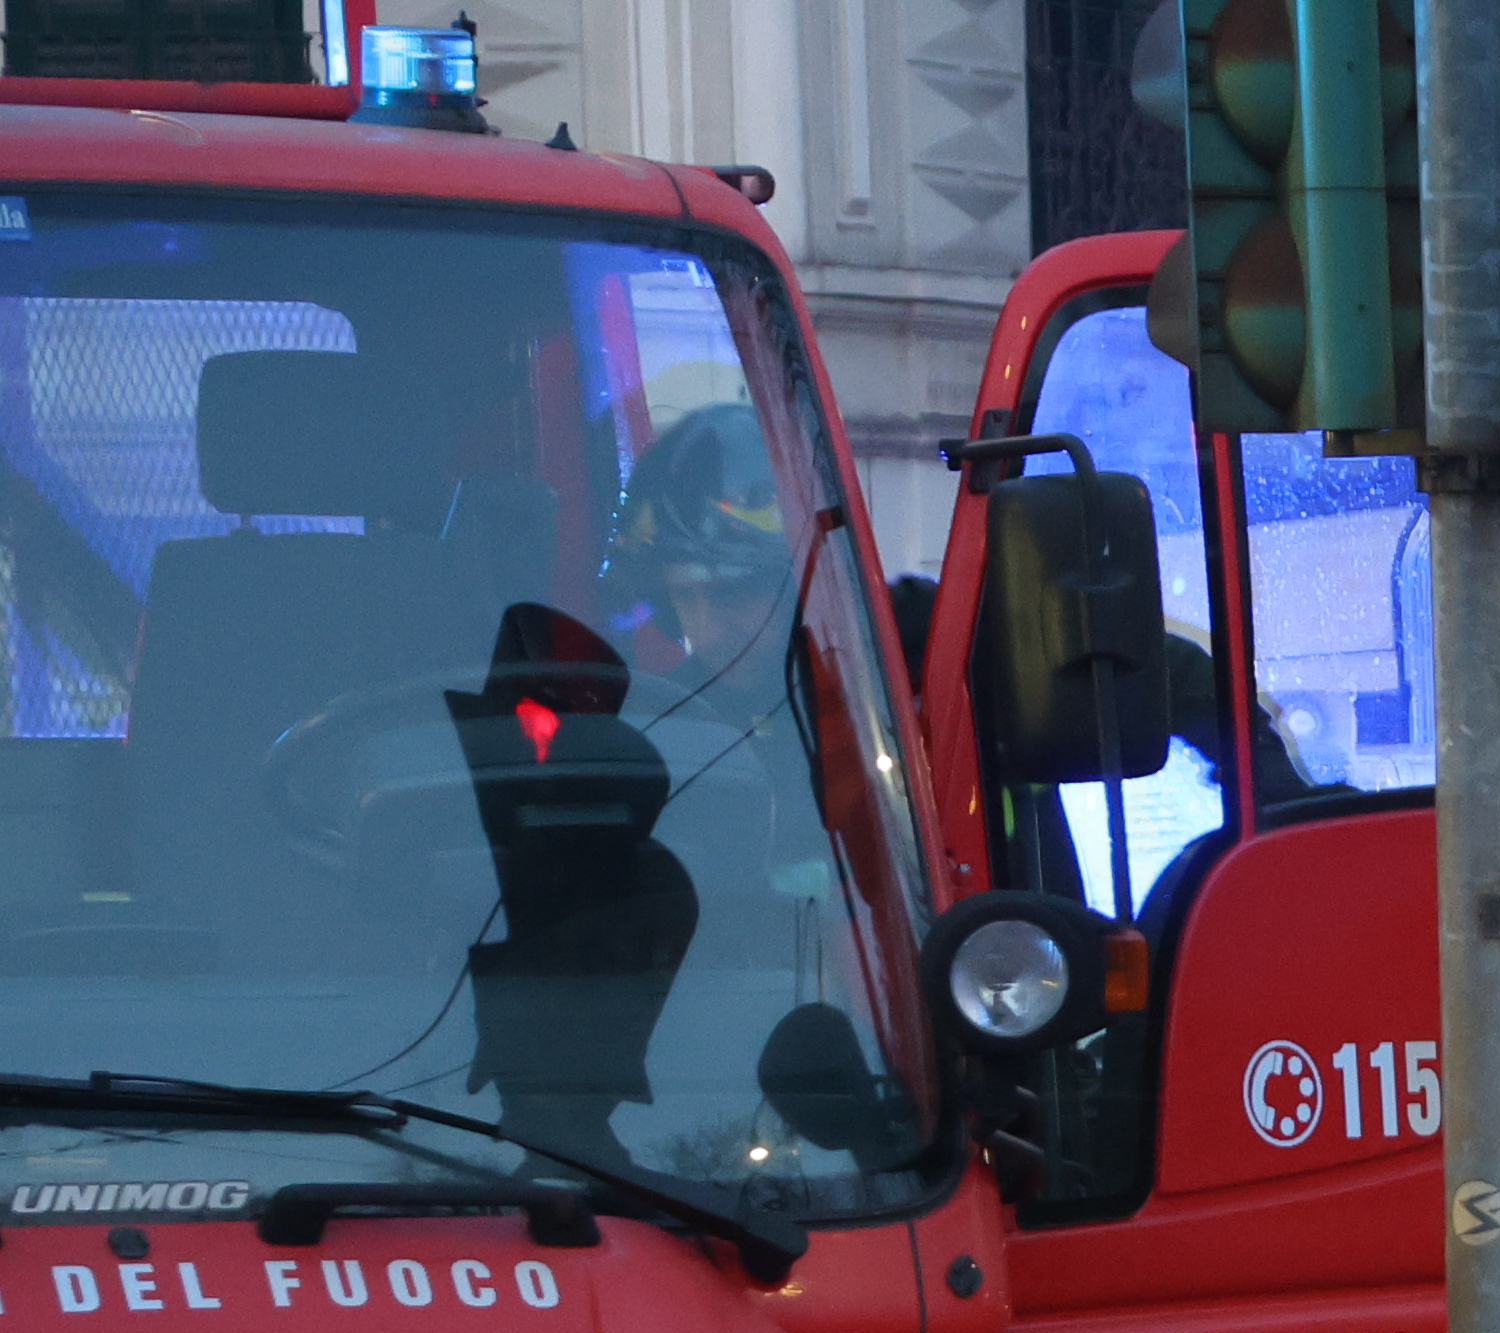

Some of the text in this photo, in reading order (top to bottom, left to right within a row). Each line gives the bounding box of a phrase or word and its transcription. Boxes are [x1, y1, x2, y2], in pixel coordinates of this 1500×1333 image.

[1331, 1039, 1443, 1139] 115
[10, 1179, 250, 1214] UNIMOG
[51, 1258, 561, 1313] DEL FUOCO
